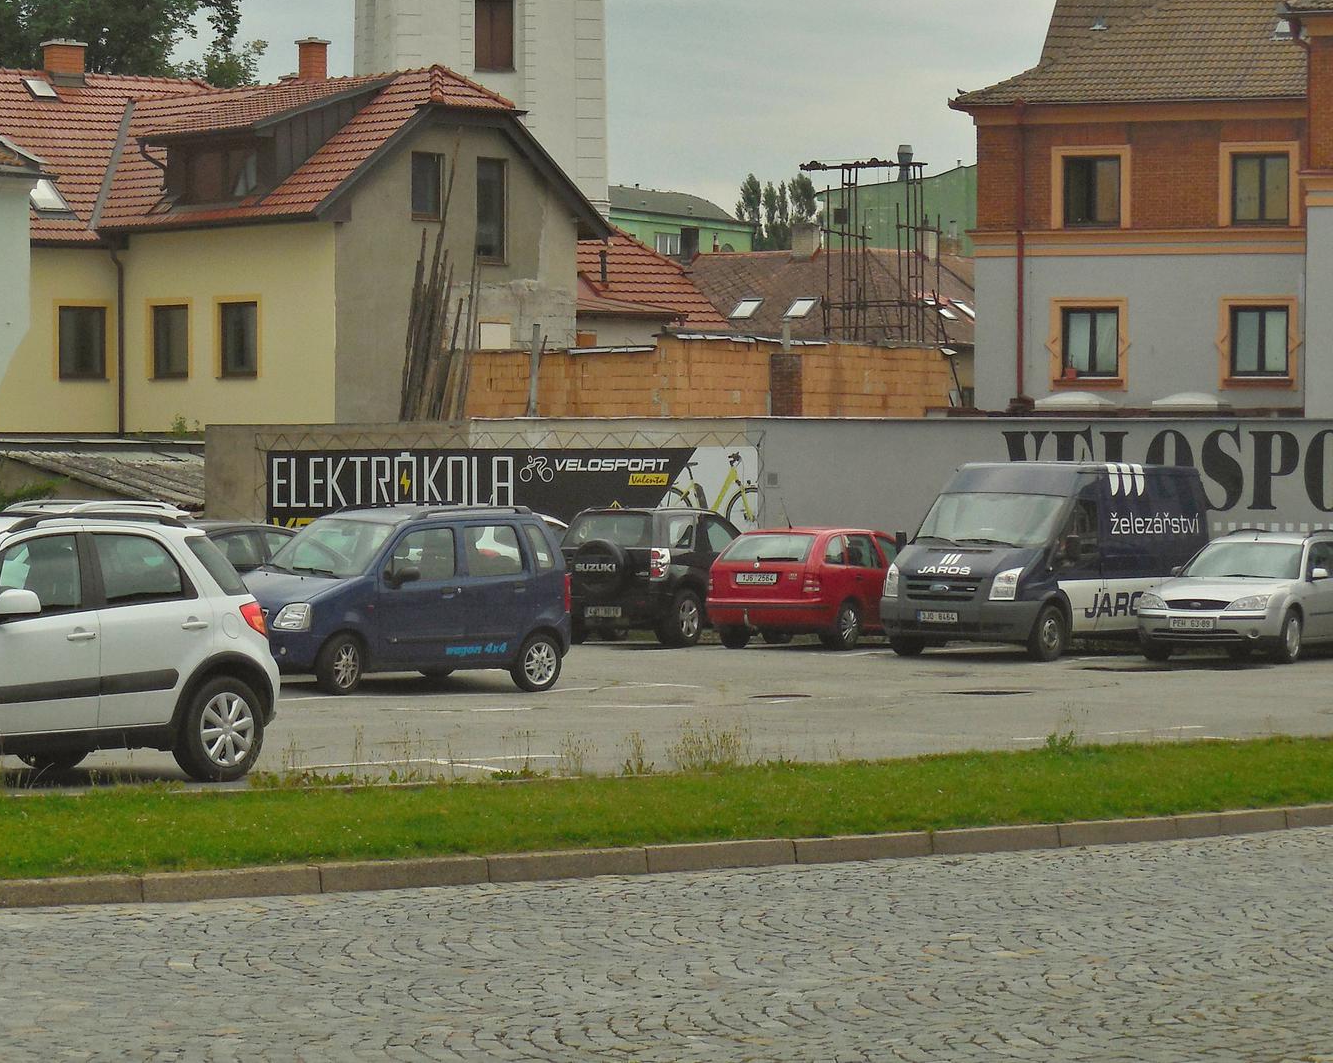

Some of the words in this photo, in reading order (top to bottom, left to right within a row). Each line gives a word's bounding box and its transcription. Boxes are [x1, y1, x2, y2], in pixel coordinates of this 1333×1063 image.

[554, 459, 669, 472] VELOSPORT
[272, 452, 514, 508] ELEKTROKOLA
[1110, 512, 1199, 535] železářství
[575, 563, 616, 572] SUZUKI
